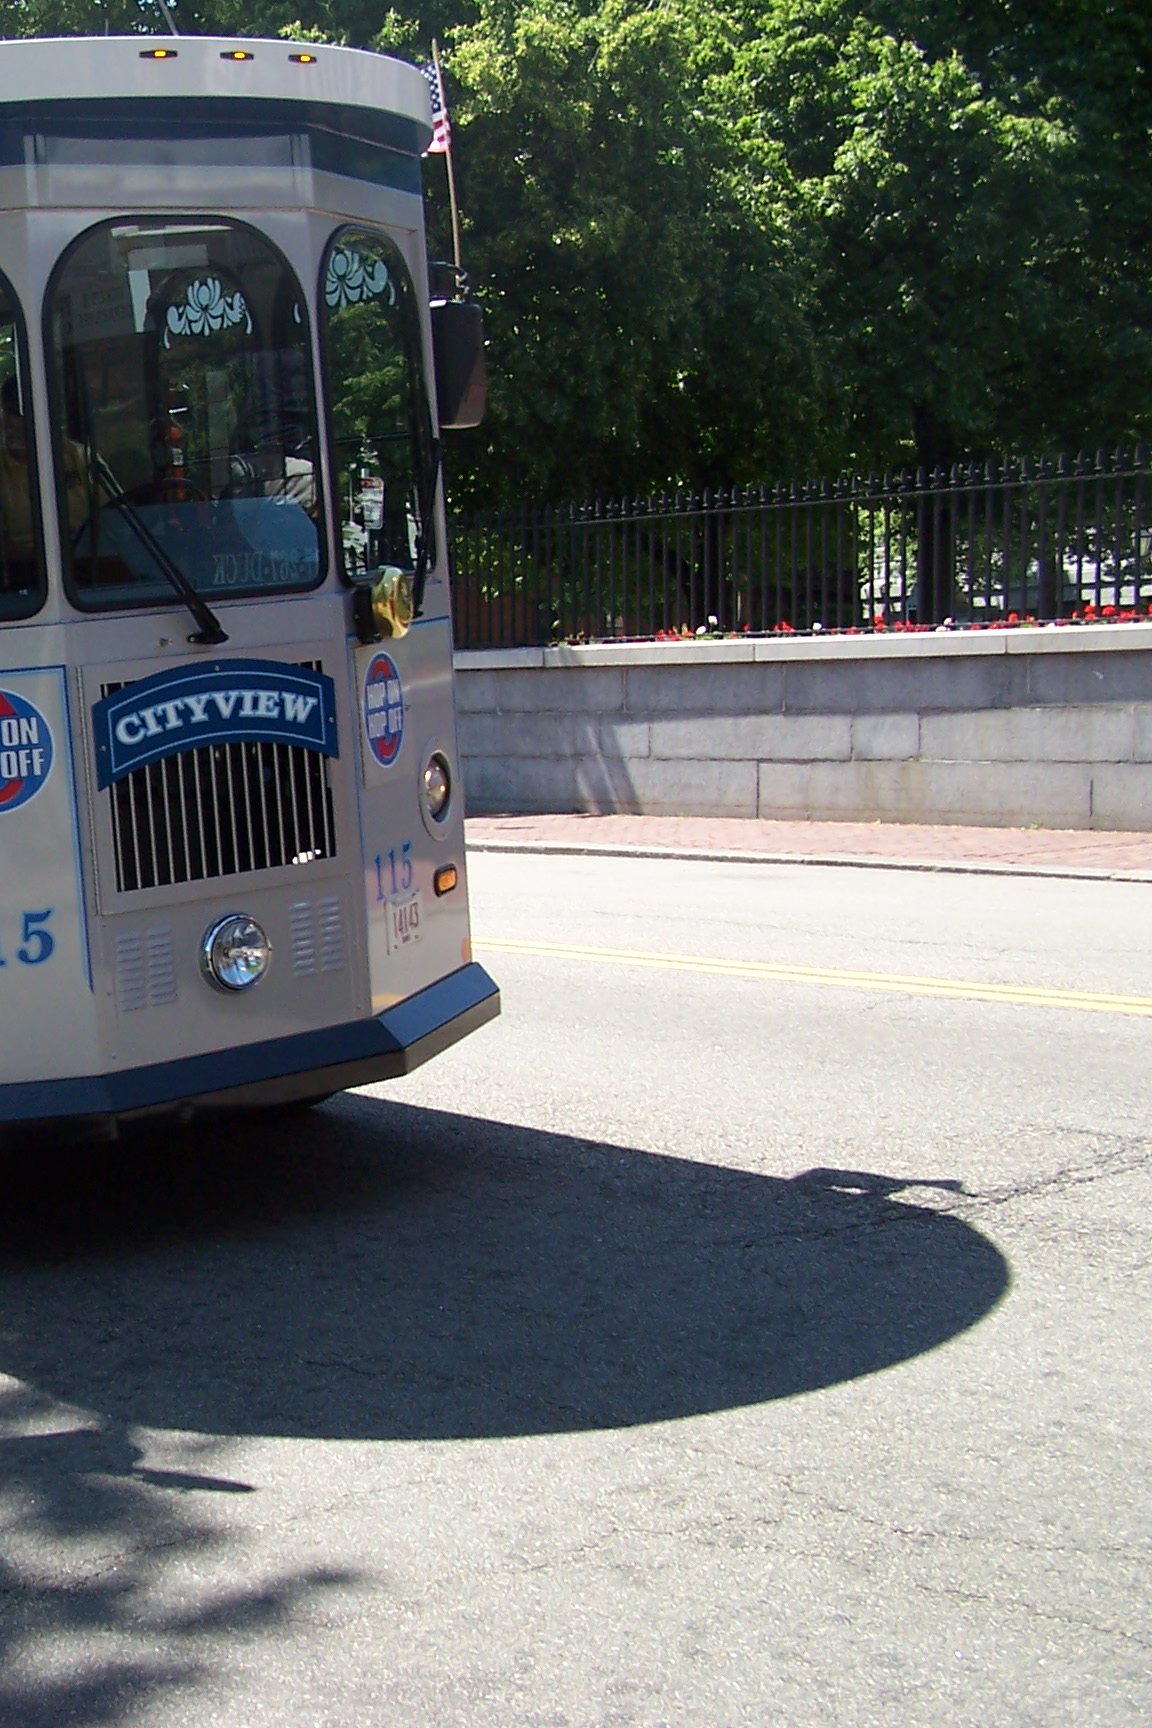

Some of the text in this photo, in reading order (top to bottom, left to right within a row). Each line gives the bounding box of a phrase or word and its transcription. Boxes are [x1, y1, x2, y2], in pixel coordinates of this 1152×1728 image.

[0, 717, 40, 747] ON
[115, 689, 318, 745] CITYVIEW
[0, 748, 45, 778] OFF
[374, 839, 412, 902] 115
